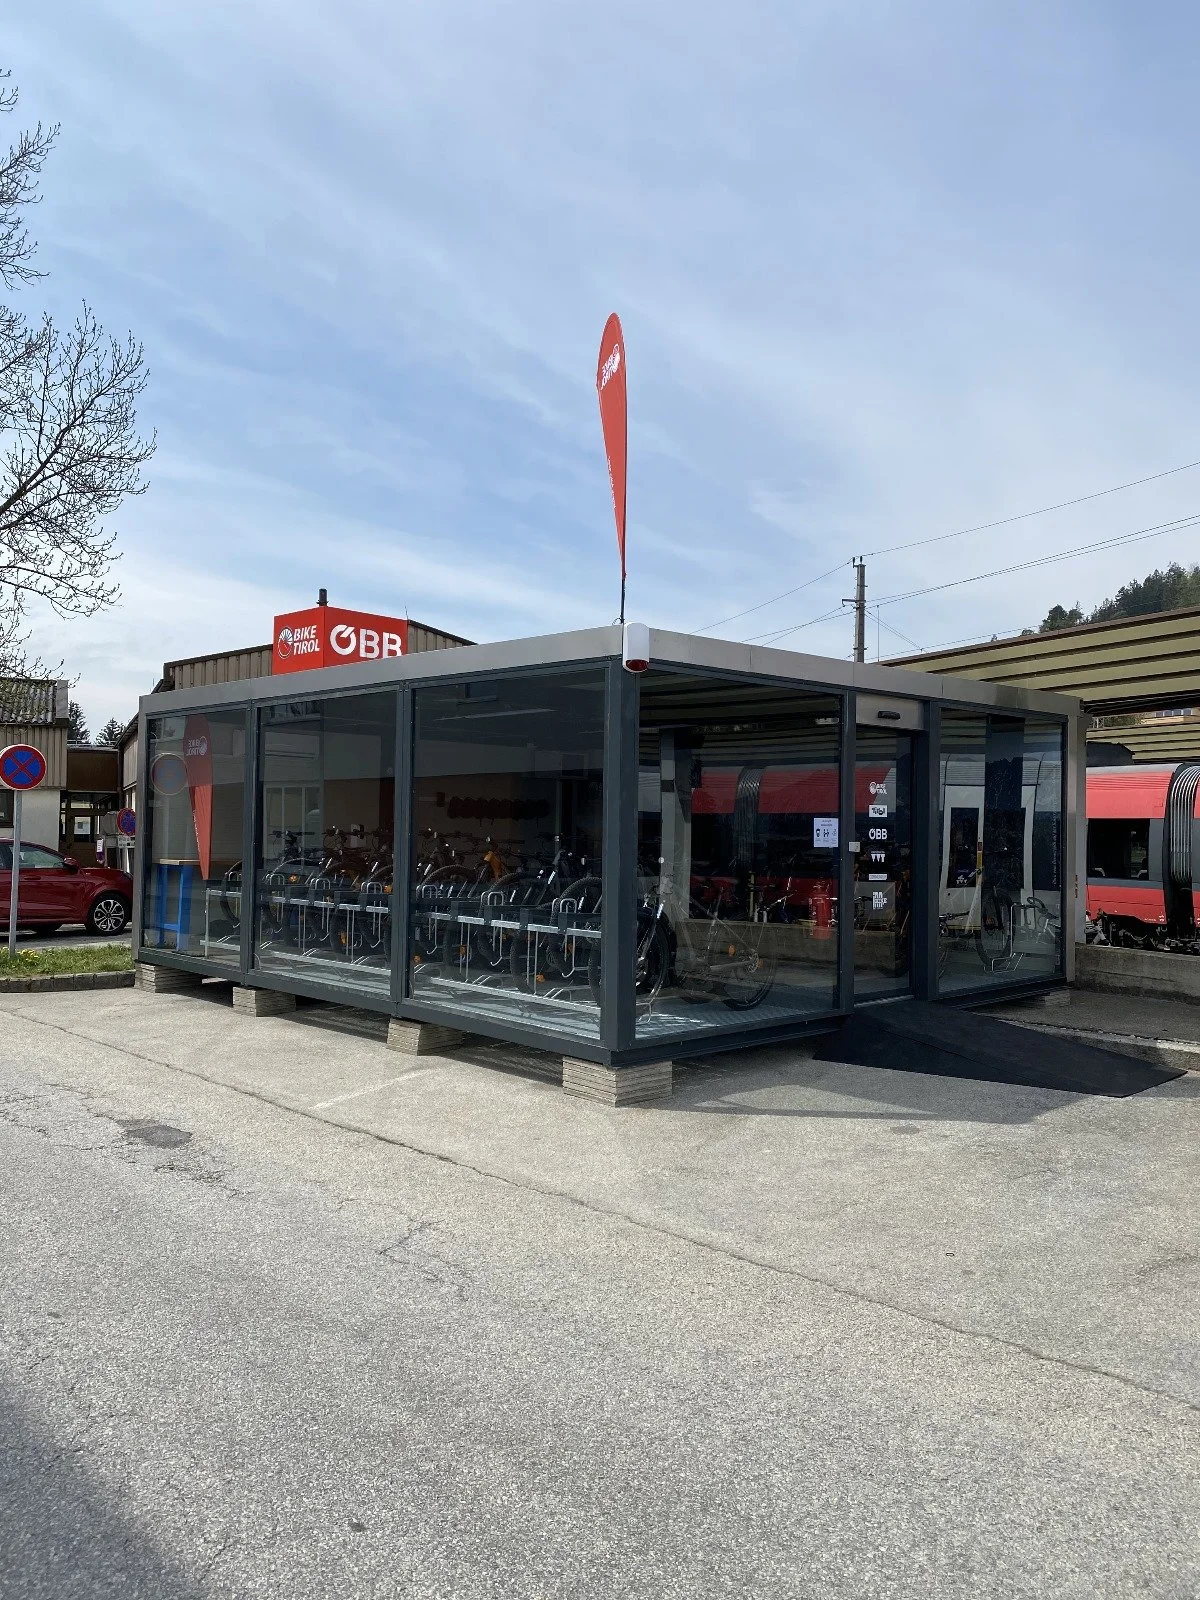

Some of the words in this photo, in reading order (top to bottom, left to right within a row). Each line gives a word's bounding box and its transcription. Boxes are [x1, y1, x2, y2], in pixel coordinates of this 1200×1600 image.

[293, 625, 317, 642] BIKE
[329, 624, 402, 659] ÖBB
[293, 639, 320, 656] TIROL
[869, 828, 888, 840] ÖBB
